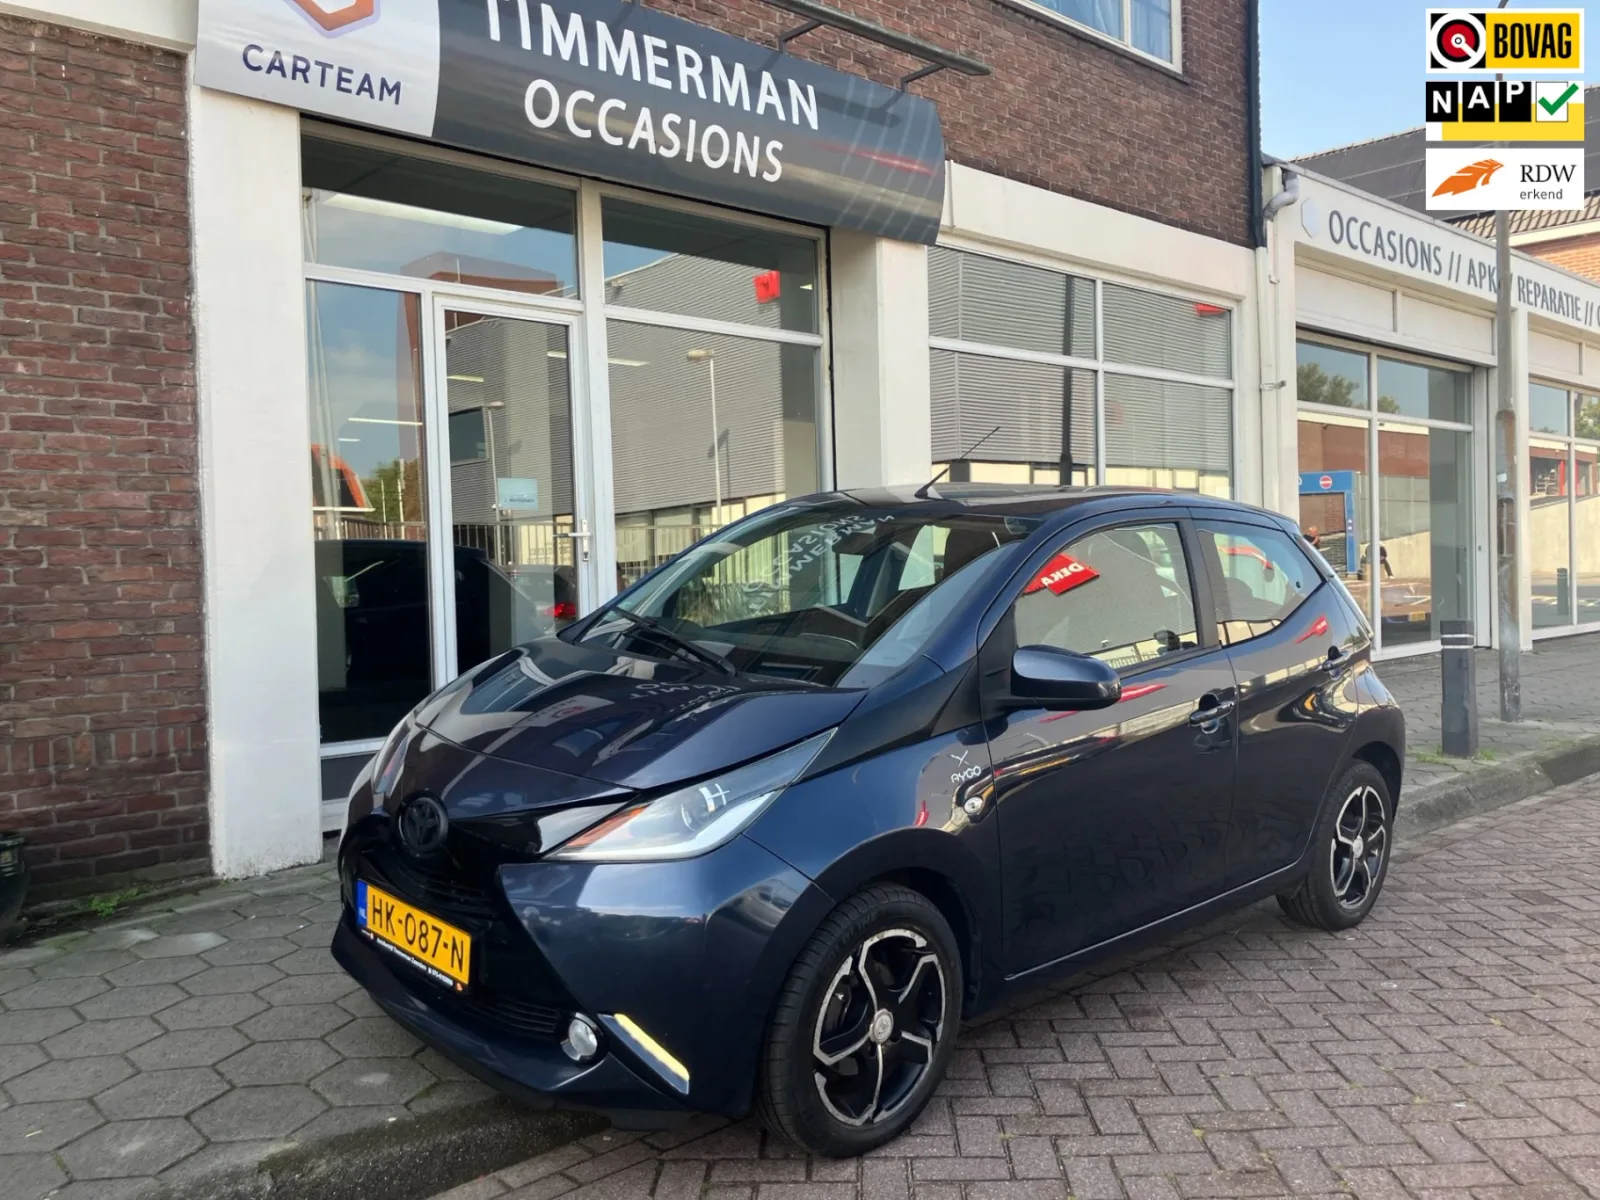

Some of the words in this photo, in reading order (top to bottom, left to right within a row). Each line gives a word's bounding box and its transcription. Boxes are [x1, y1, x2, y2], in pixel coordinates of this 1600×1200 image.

[242, 44, 402, 105] CARTEAM
[524, 79, 783, 183] OCCASIONS
[1328, 209, 1443, 276] OCCASIONS
[1467, 258, 1499, 295] APK
[1517, 275, 1583, 321] REPARATIE
[371, 894, 465, 974] HK-087-N
